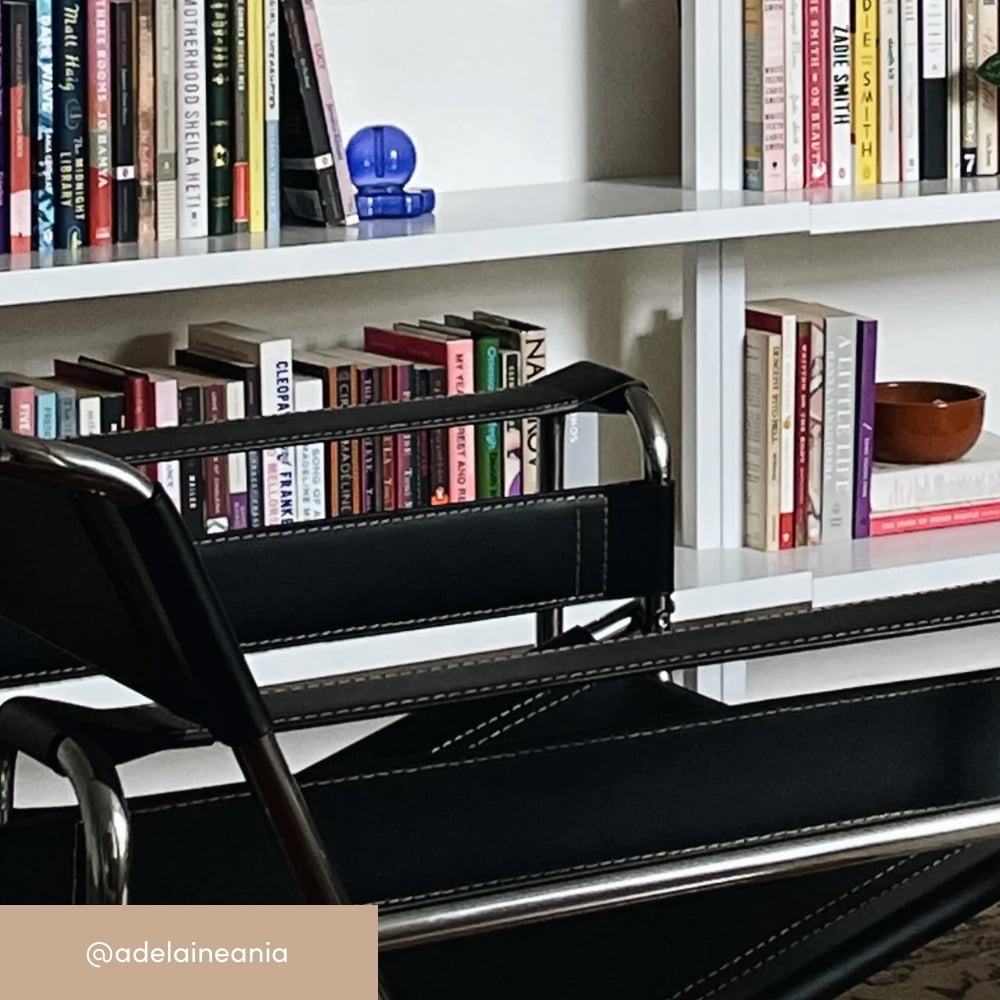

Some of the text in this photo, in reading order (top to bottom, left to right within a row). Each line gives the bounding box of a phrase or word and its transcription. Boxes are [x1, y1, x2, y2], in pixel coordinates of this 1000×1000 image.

[39, 16, 53, 113] DARK WAVE
[58, 3, 81, 91] Matt Haig
[96, 0, 108, 101] THREE ROOMS
[313, 43, 325, 70] LUCY
[810, 20, 821, 68] SMITH
[811, 87, 821, 106] ON
[833, 25, 850, 125] ZADIE SMITH
[185, 111, 201, 166] SHEILA
[862, 71, 873, 158] SMITH
[97, 110, 109, 189] JO HAMYA
[60, 151, 73, 208] LIBRARY
[74, 157, 86, 220] MIDNIGHT
[185, 173, 201, 208] HETI
[276, 360, 290, 412] CLEOPA
[456, 354, 464, 371] MY
[19, 403, 31, 432] FIVE
[800, 394, 807, 408] ON
[836, 336, 851, 495] A LITTLE LIFE
[312, 448, 321, 505] SONG OF
[341, 440, 352, 513] MADELINE
[457, 428, 467, 485] REST AND
[188, 474, 197, 509] MAILER
